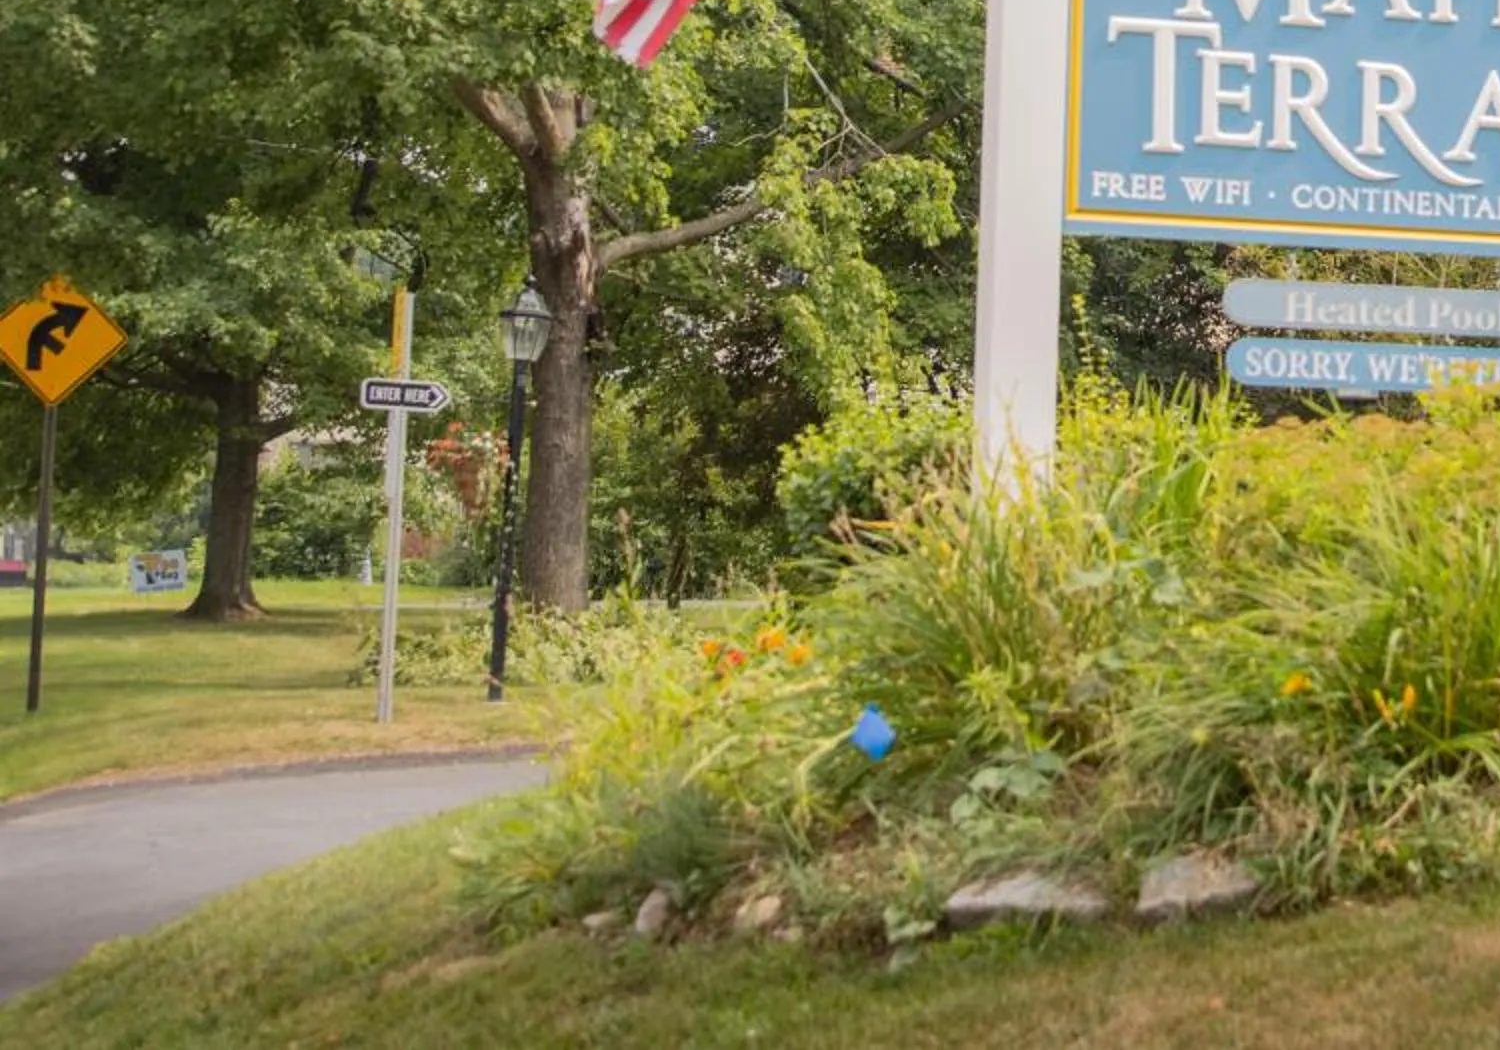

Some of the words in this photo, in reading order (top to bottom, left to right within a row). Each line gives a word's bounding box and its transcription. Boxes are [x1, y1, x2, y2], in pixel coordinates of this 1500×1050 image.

[1091, 170, 1167, 201] FREE
[1180, 176, 1251, 206] WIFI
[1284, 290, 1415, 328] Heated
[369, 385, 401, 402] ENTER
